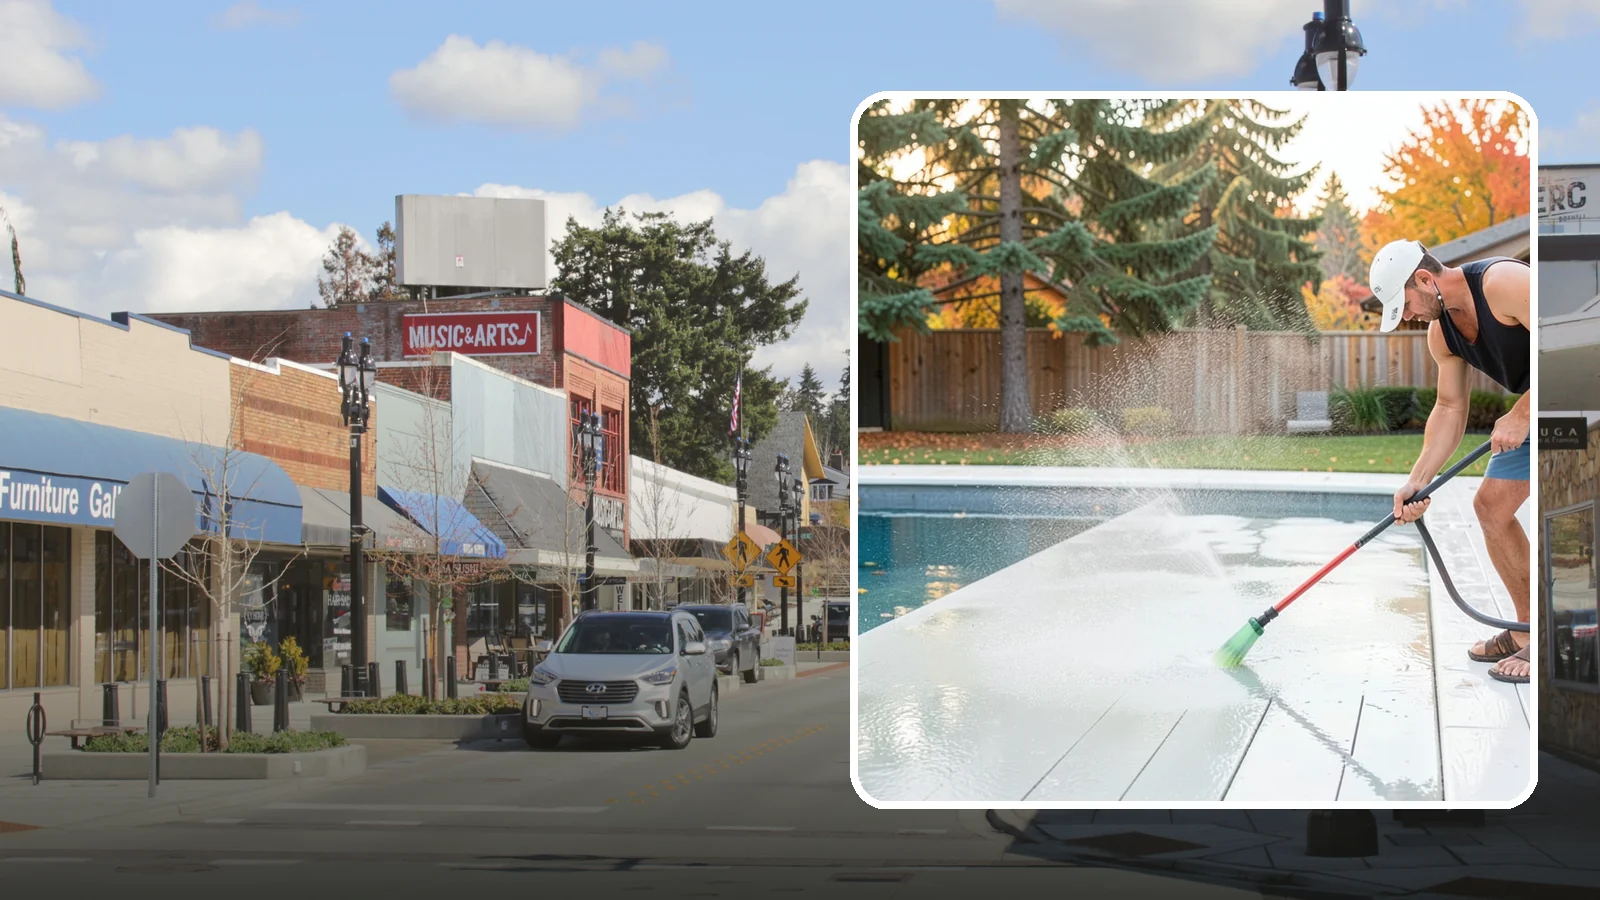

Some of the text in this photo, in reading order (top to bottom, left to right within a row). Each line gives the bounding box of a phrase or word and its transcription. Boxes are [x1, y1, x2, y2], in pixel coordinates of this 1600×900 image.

[409, 323, 520, 349] MUSIC&ARTS
[1540, 427, 1577, 437] UGA
[0, 472, 122, 519] Furniture Gal
[453, 563, 479, 574] SUSHI
